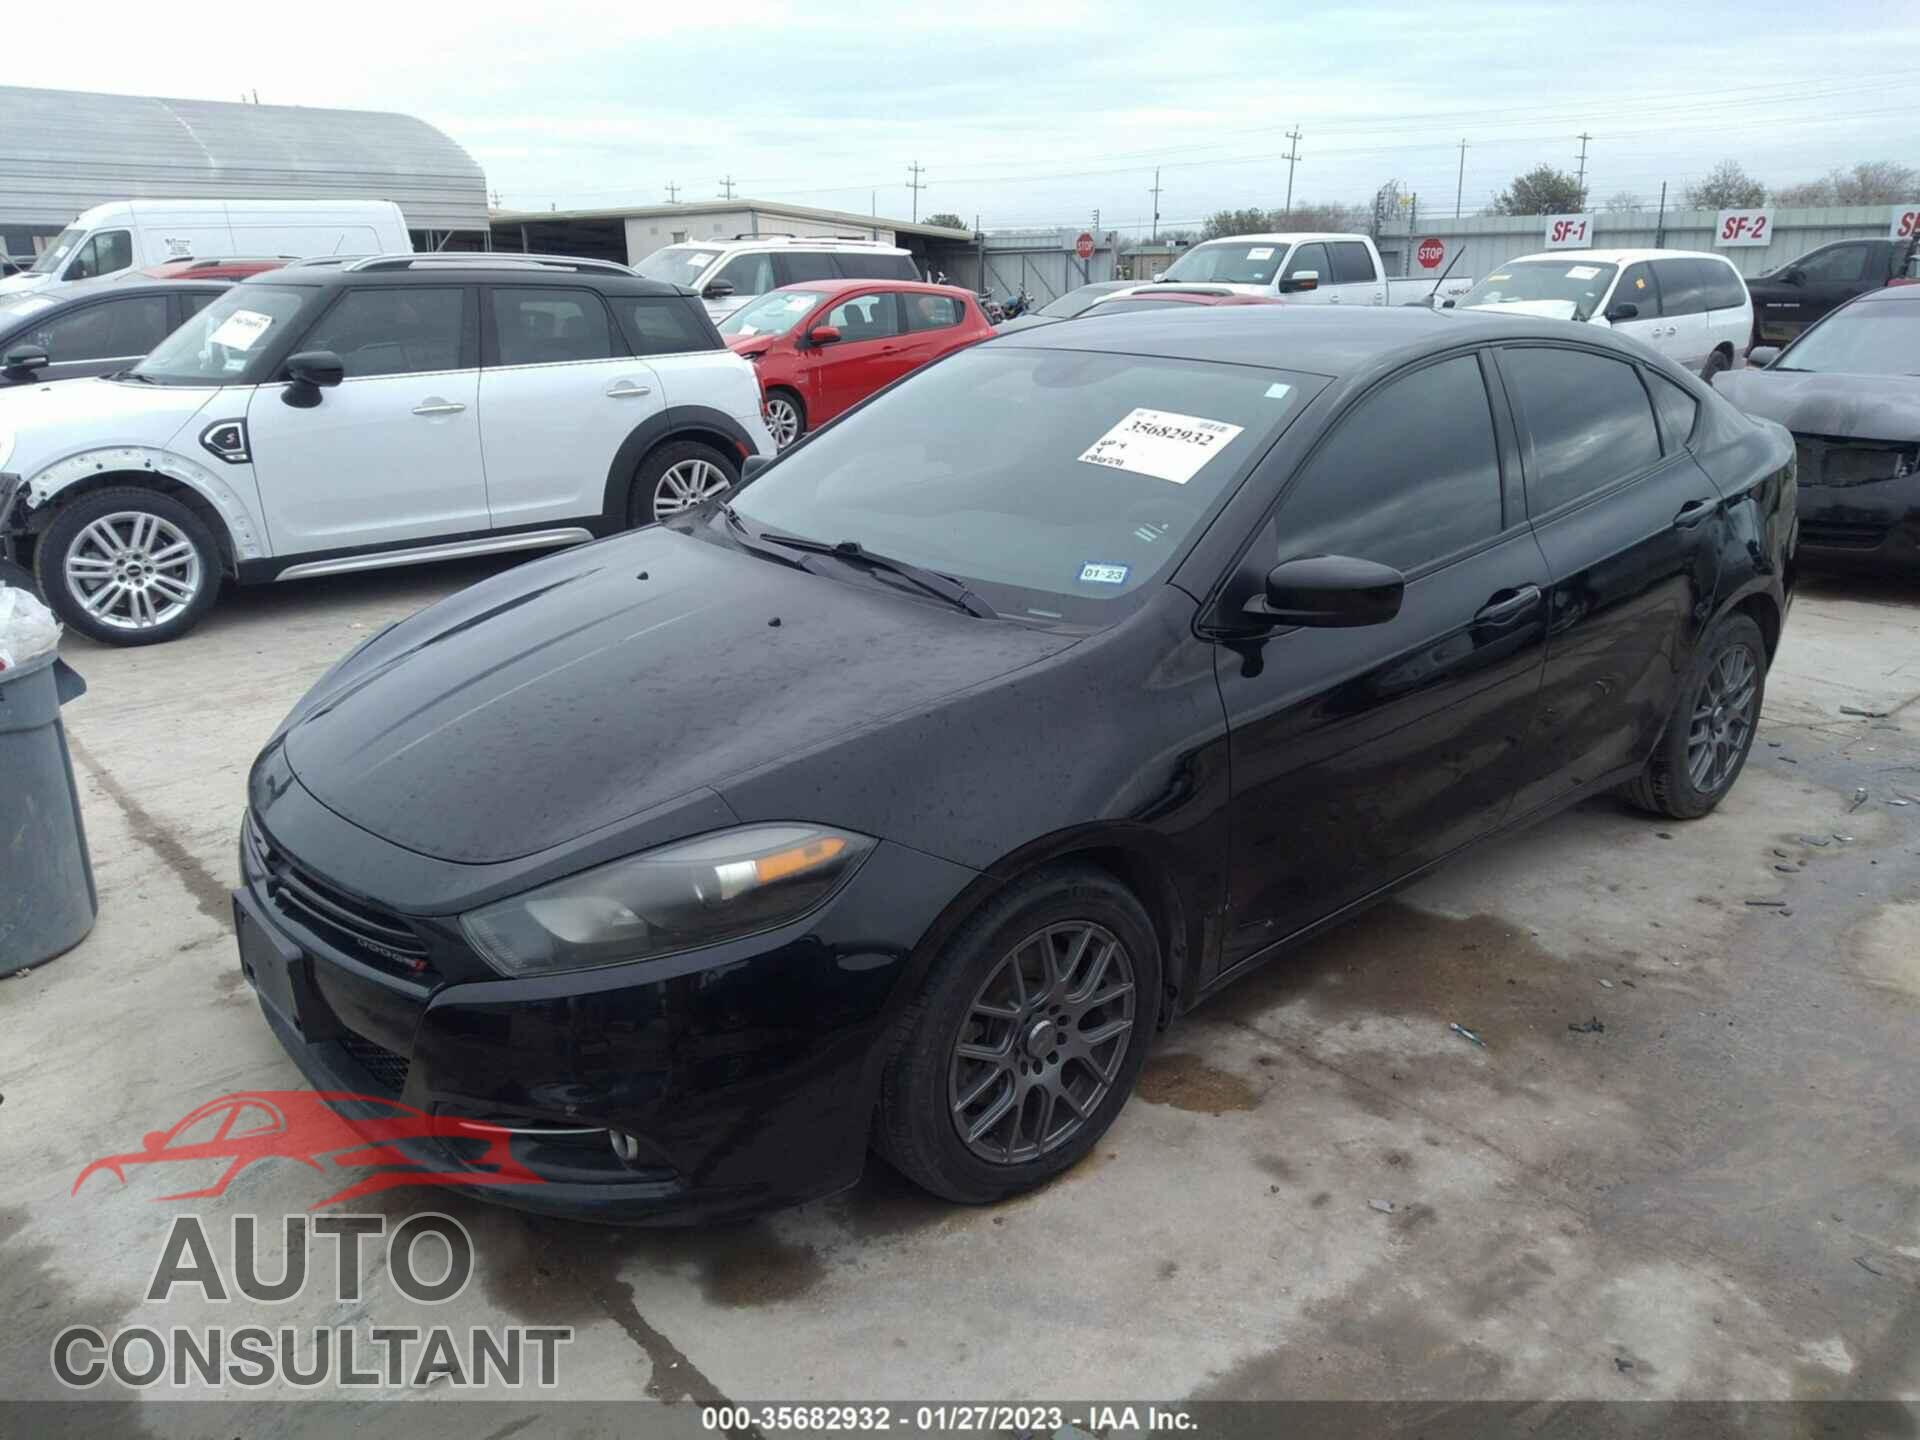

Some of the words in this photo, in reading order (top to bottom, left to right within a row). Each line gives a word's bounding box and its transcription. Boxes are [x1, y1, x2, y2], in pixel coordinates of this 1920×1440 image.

[1551, 220, 1586, 242] SF-1
[1722, 215, 1767, 240] SF-2
[1077, 239, 1094, 251] STOP
[1418, 246, 1443, 260] STOP
[1125, 419, 1215, 447] 35682932
[1084, 567, 1123, 580] 01-23
